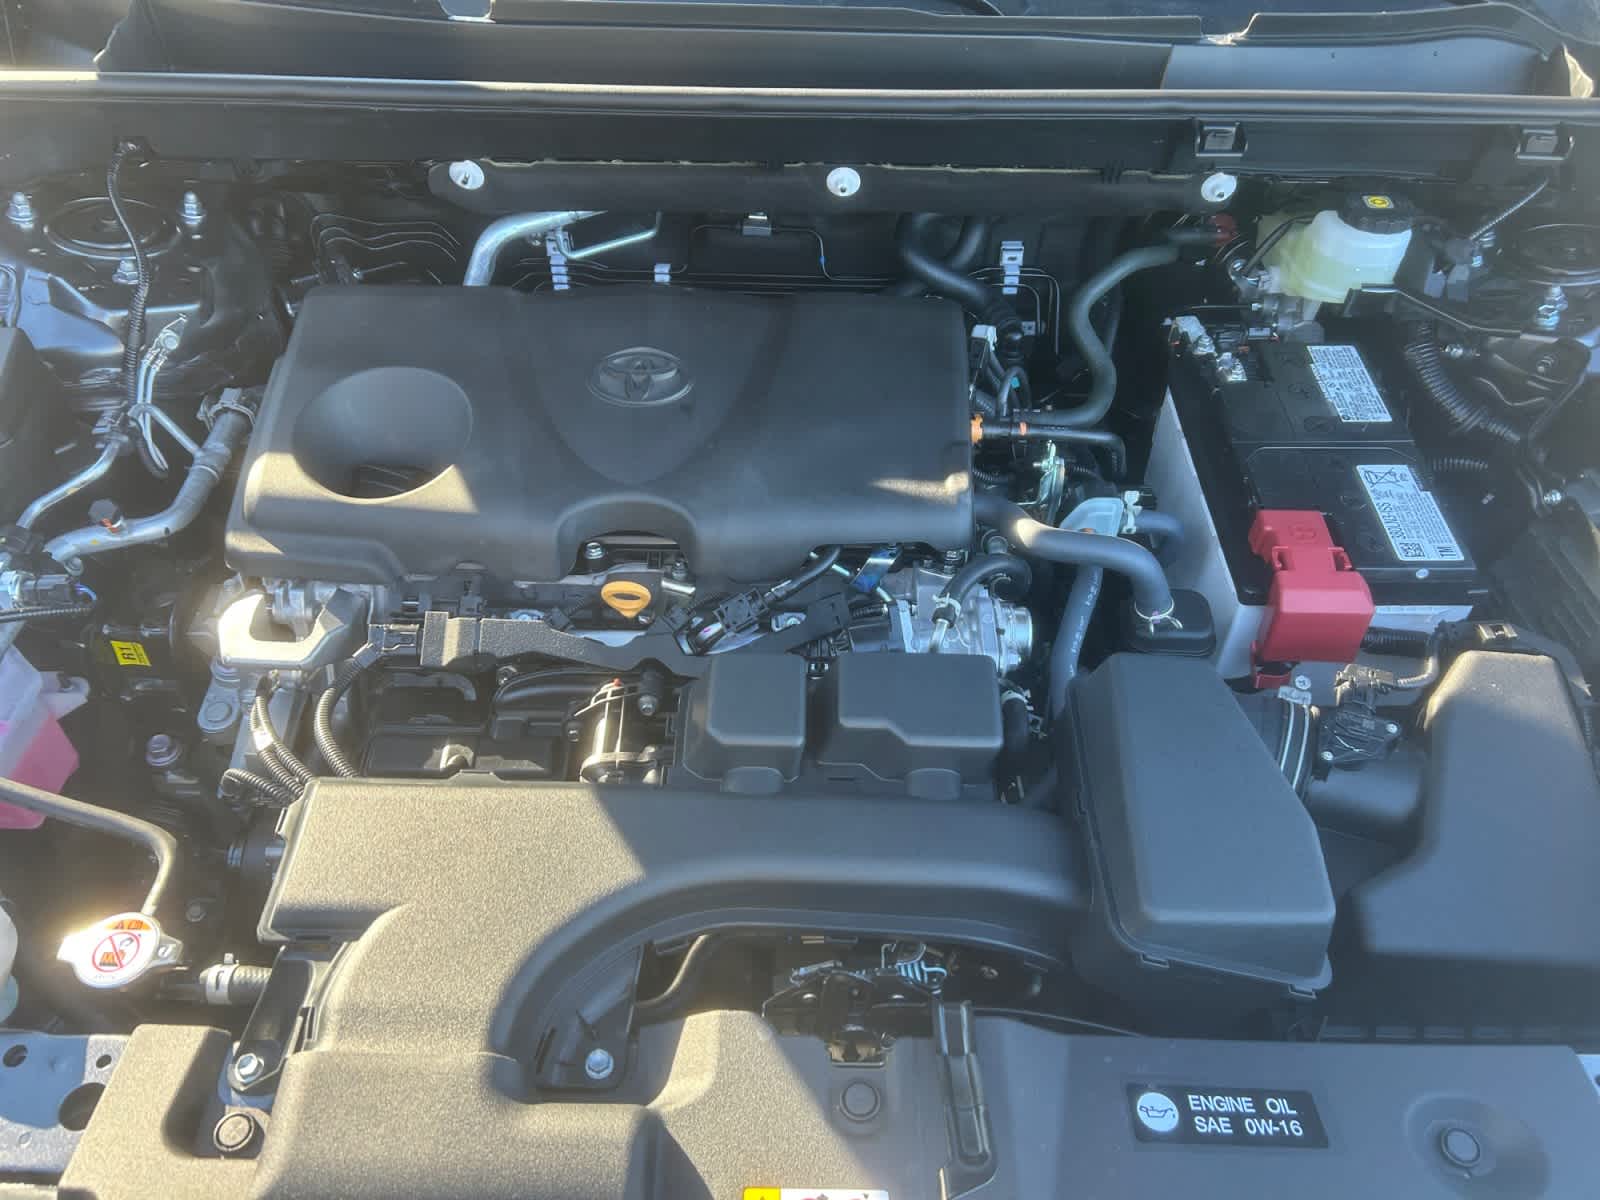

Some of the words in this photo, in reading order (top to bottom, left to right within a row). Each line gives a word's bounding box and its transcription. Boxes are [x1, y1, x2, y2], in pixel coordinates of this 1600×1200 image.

[1188, 1095, 1256, 1113] ENGINE
[1265, 1098, 1297, 1115] OIL
[1194, 1116, 1233, 1134] SAE
[1244, 1118, 1303, 1137] 0W-16
